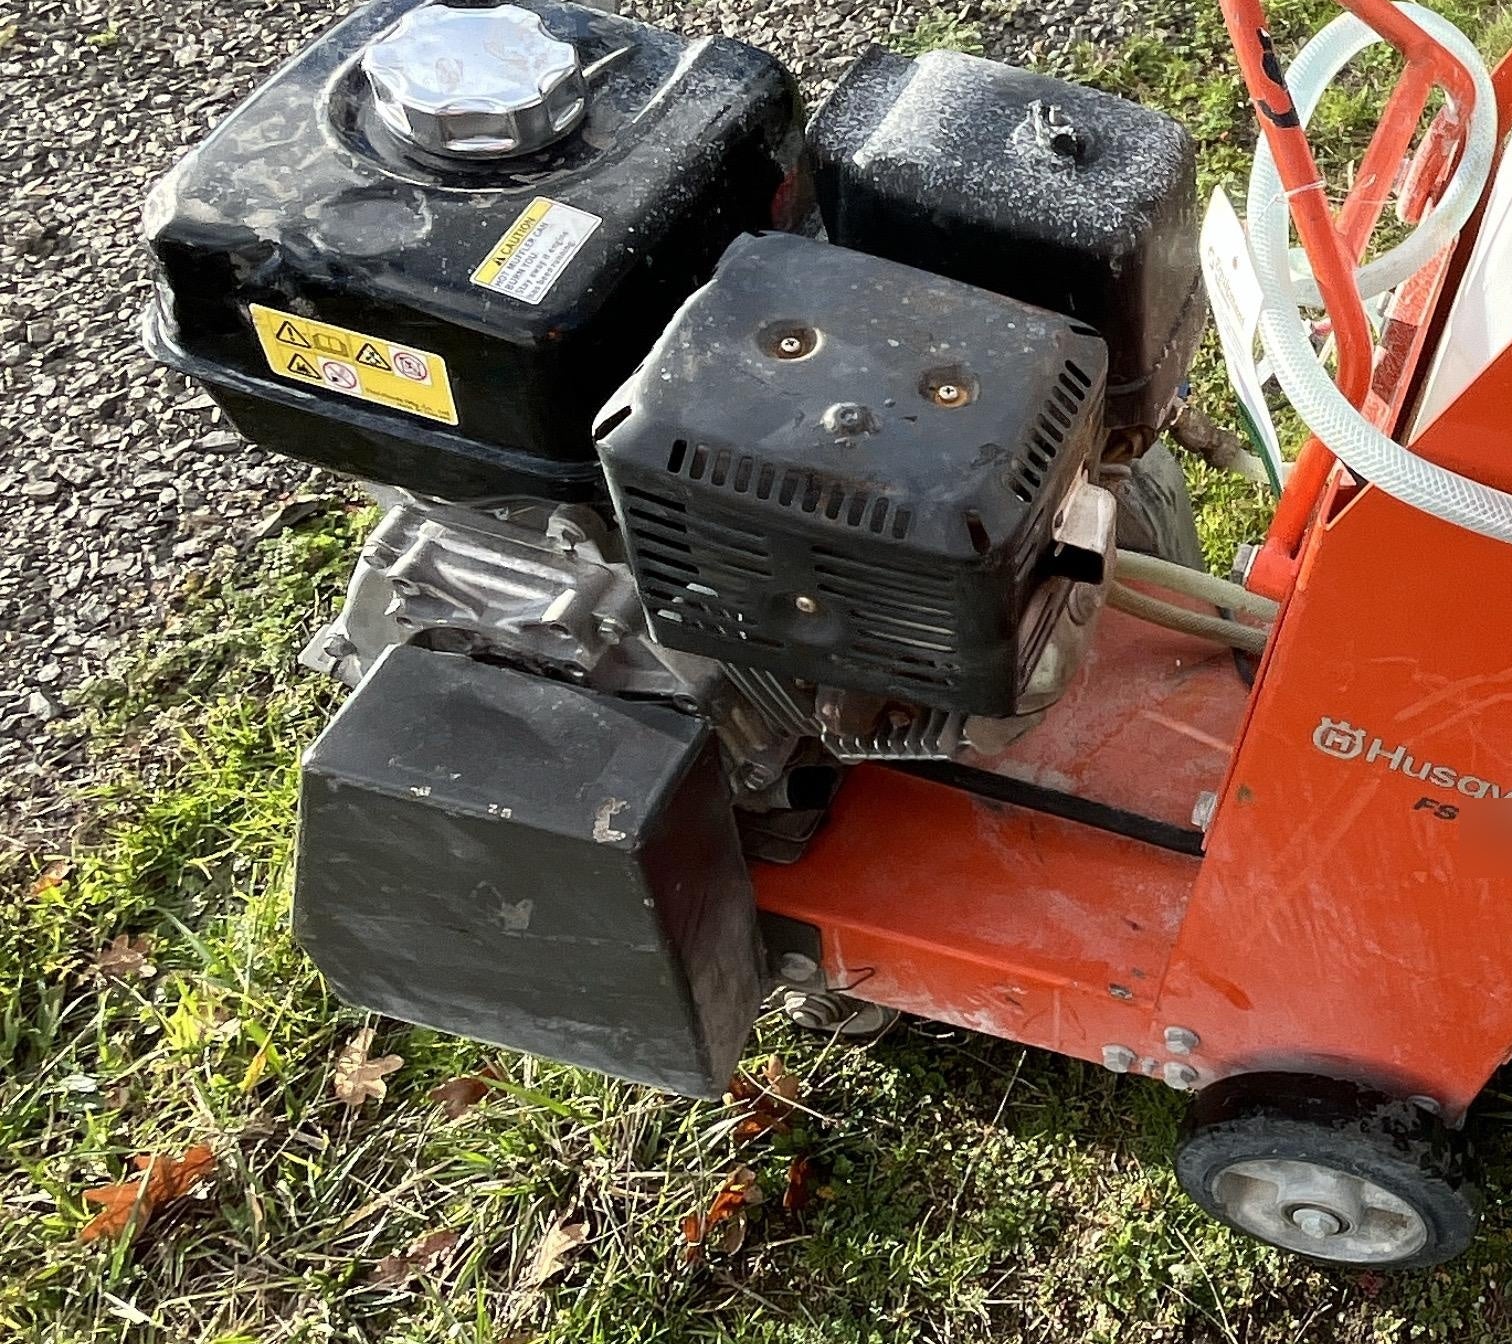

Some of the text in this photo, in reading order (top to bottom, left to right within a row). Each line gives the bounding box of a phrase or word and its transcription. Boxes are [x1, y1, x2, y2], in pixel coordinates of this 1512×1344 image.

[499, 216, 537, 255] CAUTION
[494, 221, 549, 287] HOT MUFFLER CAN
[504, 268, 526, 291] BURN
[1413, 796, 1460, 821] FS
